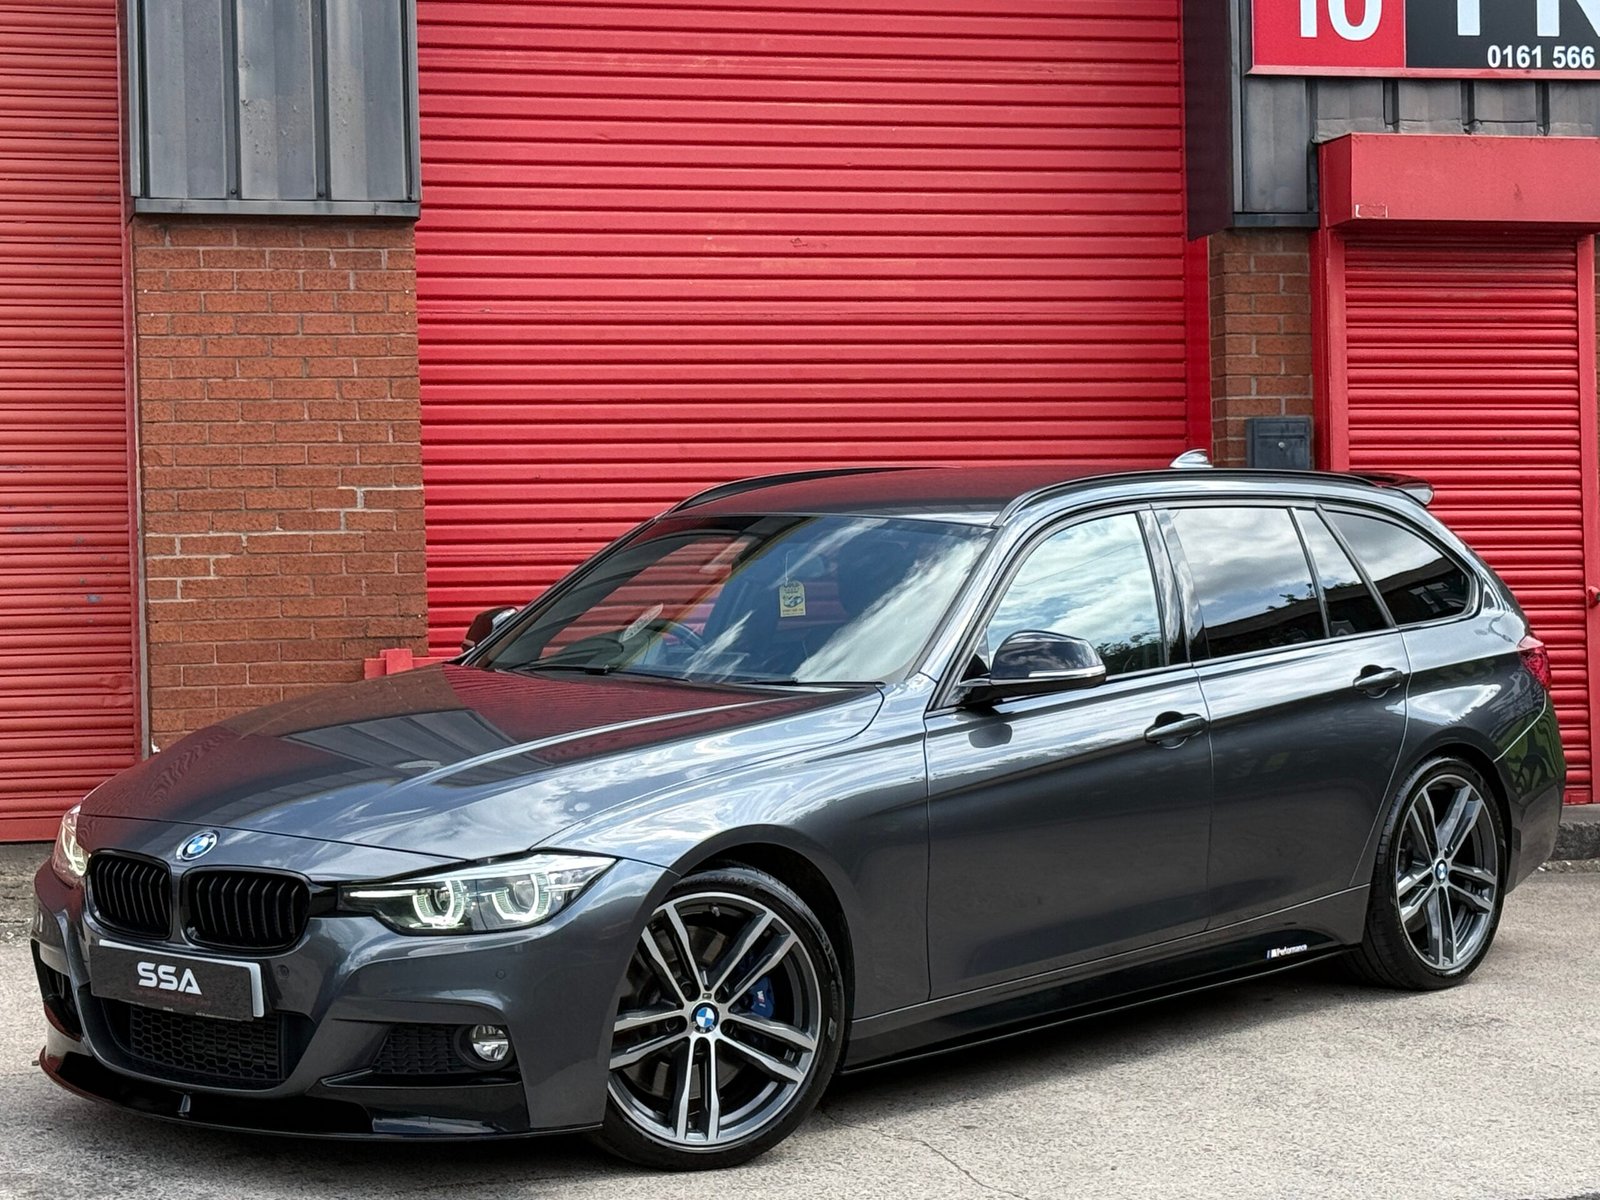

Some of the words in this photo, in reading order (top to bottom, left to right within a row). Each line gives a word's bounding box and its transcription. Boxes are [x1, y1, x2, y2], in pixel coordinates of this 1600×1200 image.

[1487, 45, 1543, 68] 0161
[1552, 46, 1595, 69] 566
[137, 961, 203, 995] SSA
